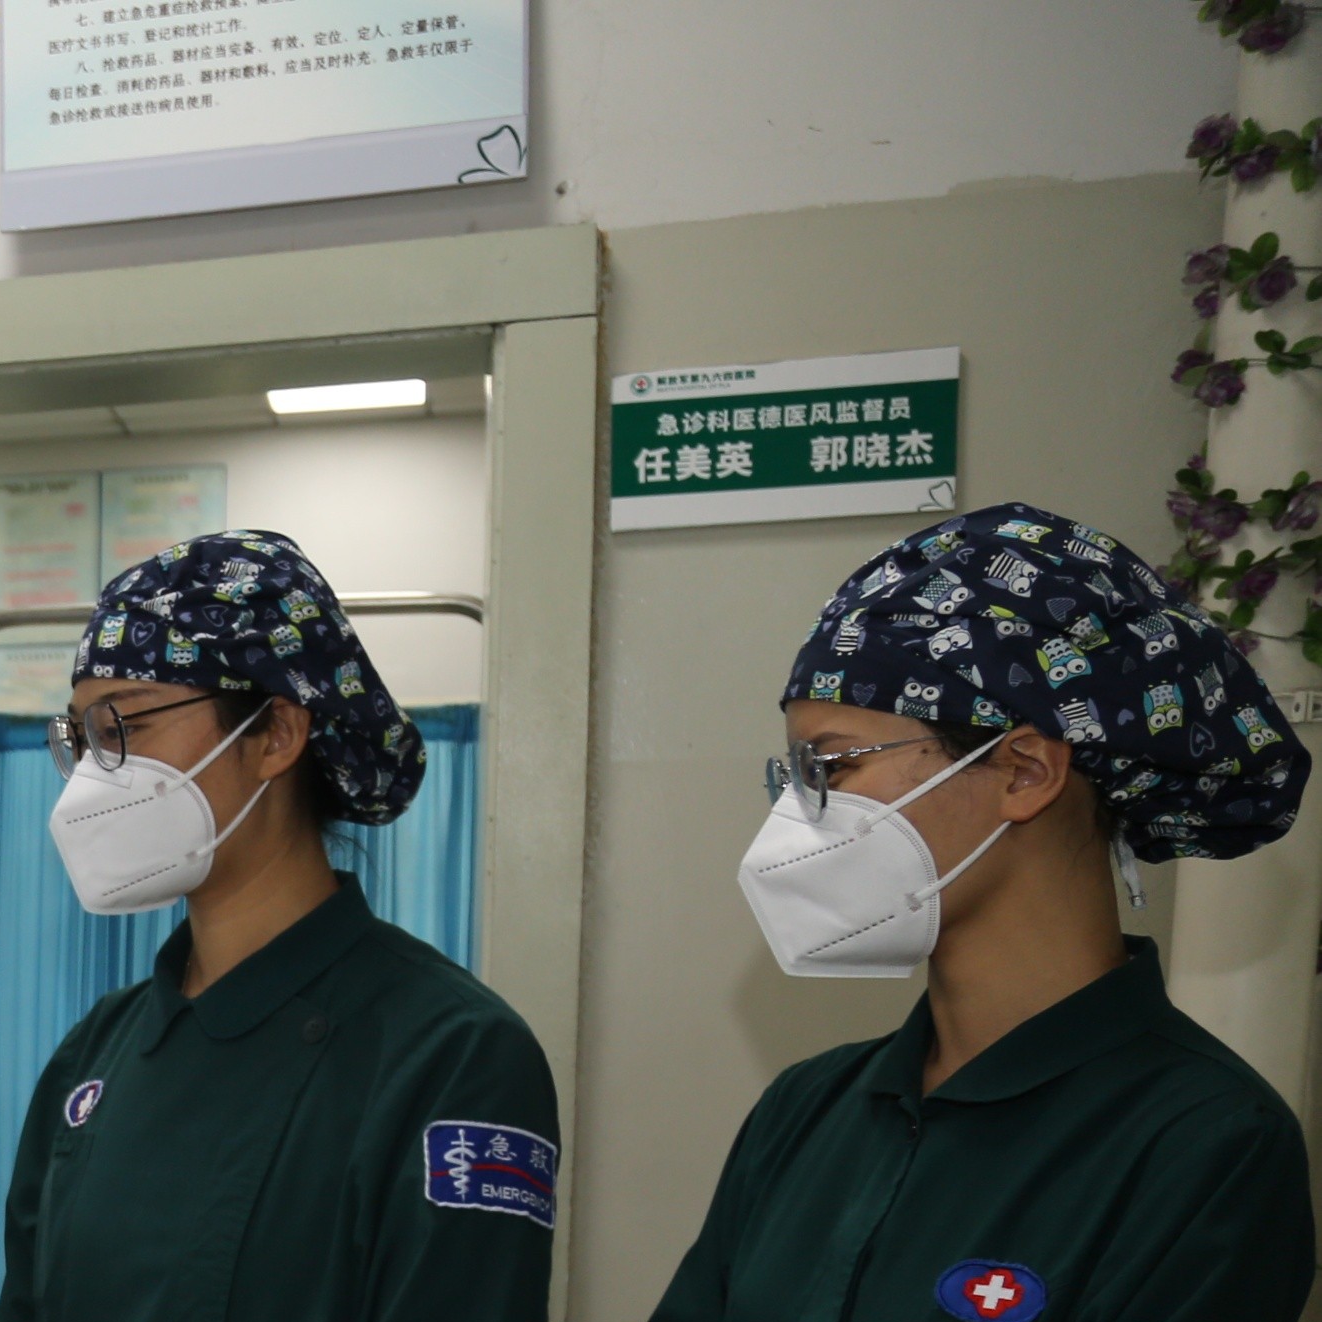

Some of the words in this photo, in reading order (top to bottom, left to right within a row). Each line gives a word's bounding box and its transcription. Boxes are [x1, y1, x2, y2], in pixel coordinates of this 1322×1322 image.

[657, 397, 911, 436] 急诊科医德医风监督员
[634, 440, 753, 484] 任美英
[810, 429, 934, 473] 郭晓杰
